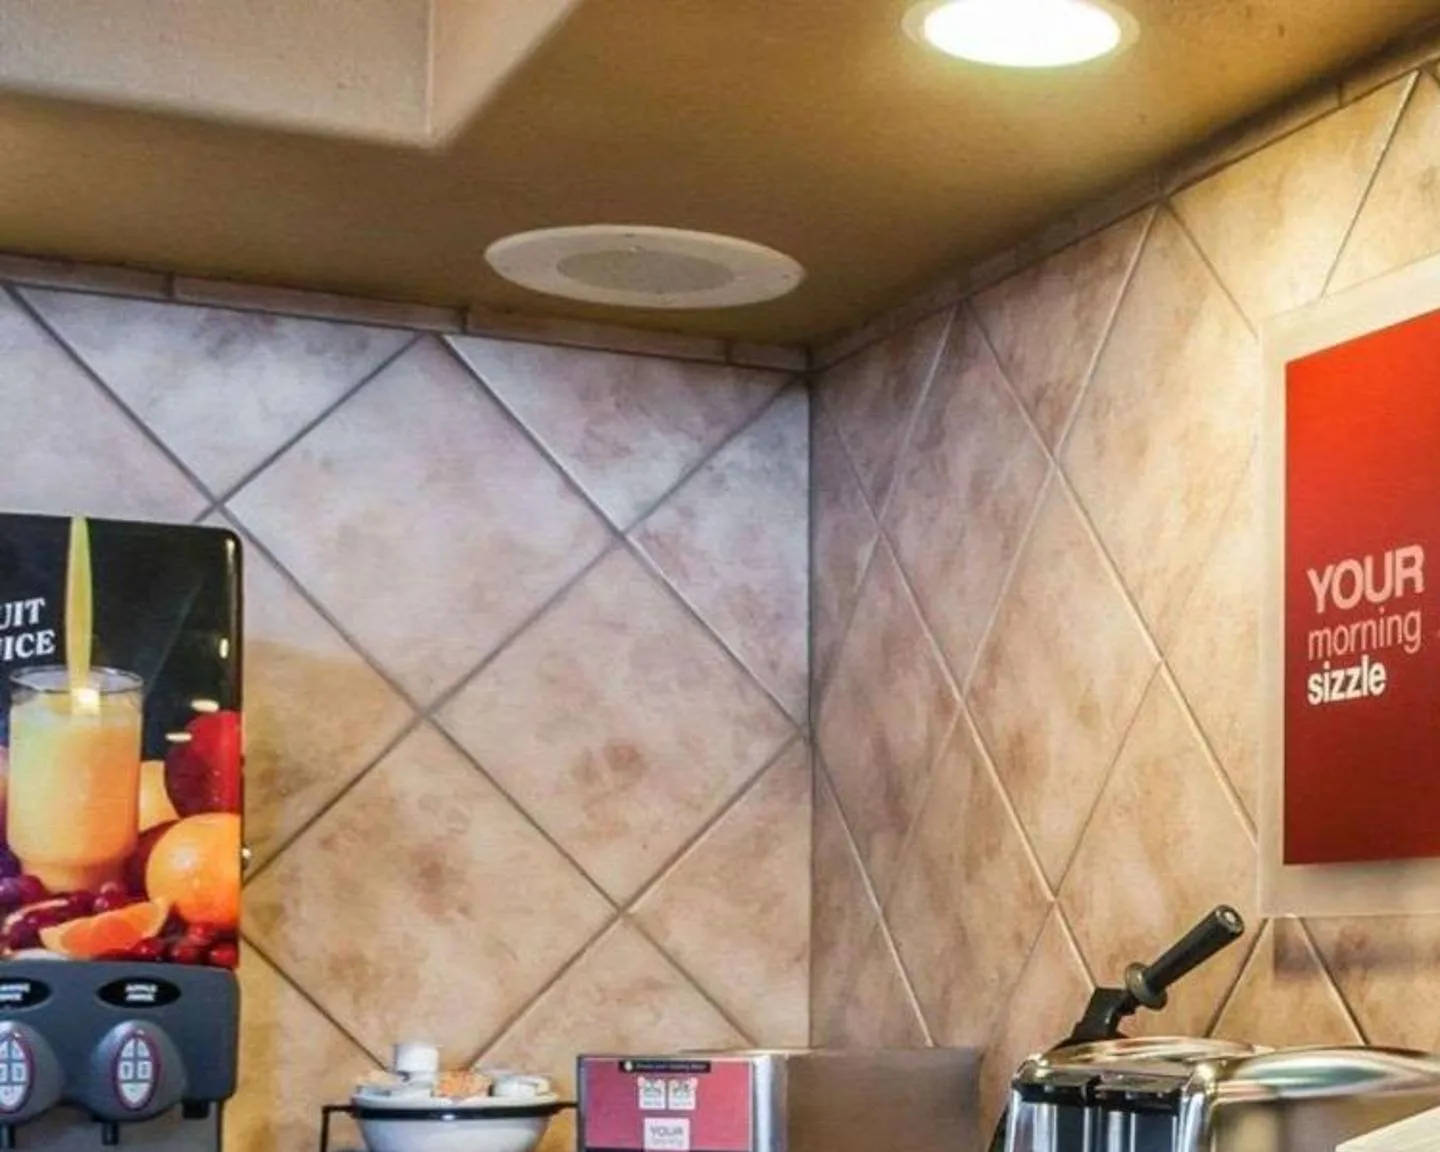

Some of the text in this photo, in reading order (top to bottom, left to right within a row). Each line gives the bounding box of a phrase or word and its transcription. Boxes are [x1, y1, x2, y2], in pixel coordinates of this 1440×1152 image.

[1307, 545, 1424, 614] YOUR
[0, 630, 56, 661] ICE
[1308, 606, 1422, 661] morning
[1307, 654, 1387, 705] sizzle
